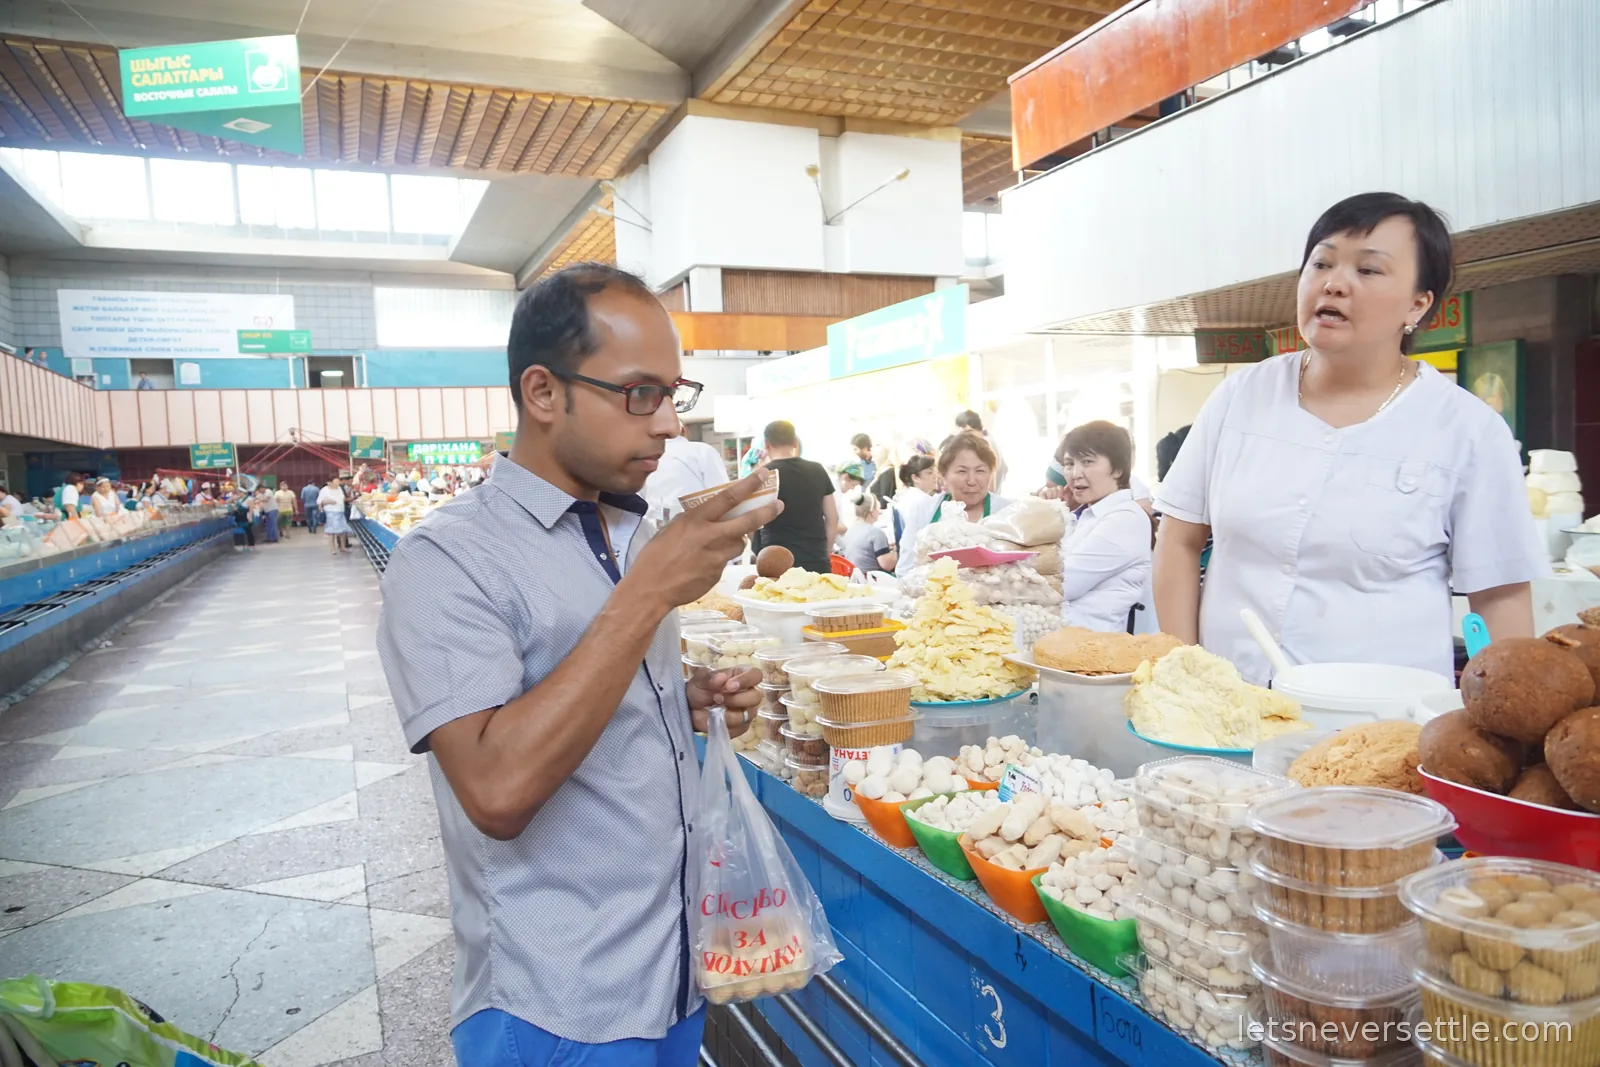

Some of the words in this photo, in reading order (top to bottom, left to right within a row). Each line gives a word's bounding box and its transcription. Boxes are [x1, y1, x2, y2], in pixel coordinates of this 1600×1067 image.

[131, 67, 224, 87] САЛАТТАРЫ
[133, 88, 195, 102] ВОСТОЧНЫЕ
[196, 85, 239, 98] САЛАТЫ
[833, 747, 870, 761] ЕТАНА
[734, 928, 766, 949] ЗА
